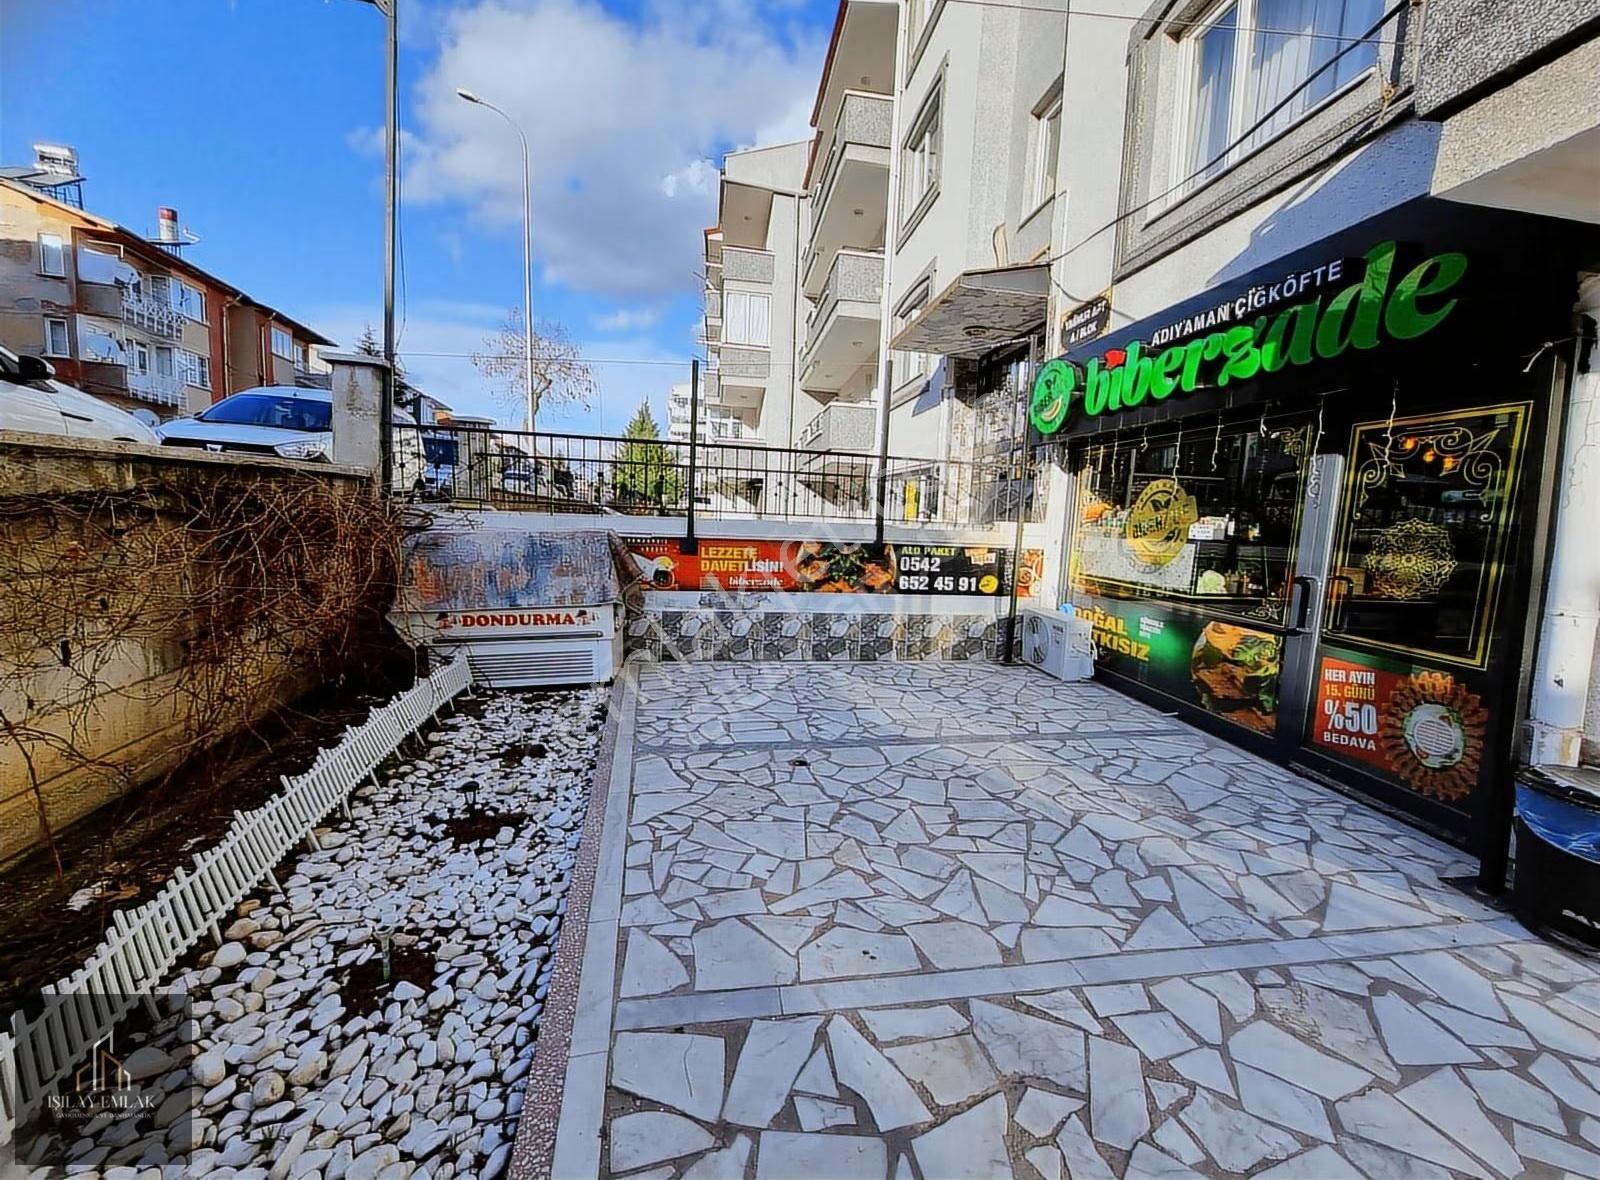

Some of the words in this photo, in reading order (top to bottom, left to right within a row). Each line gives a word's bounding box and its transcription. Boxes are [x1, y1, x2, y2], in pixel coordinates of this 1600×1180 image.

[1152, 301, 1230, 346] ADIYAMAN
[1234, 260, 1342, 319] ÇİĞKÖFTE
[1085, 241, 1468, 416] biberzade
[701, 547, 757, 559] LEZZETE
[926, 547, 957, 556] PAKET
[900, 556, 941, 572] 0542
[899, 576, 929, 590] 652
[934, 577, 954, 591] 45
[958, 577, 977, 591] 91
[462, 612, 575, 627] DONDURMA
[1092, 629, 1151, 662] TKISIZ
[1325, 668, 1346, 682] HER
[1349, 671, 1376, 685] AYIN
[1325, 683, 1341, 697] 15.
[1344, 683, 1375, 701] GÜNÜ
[1324, 699, 1377, 735] %50
[1324, 731, 1377, 752] BEDAVA
